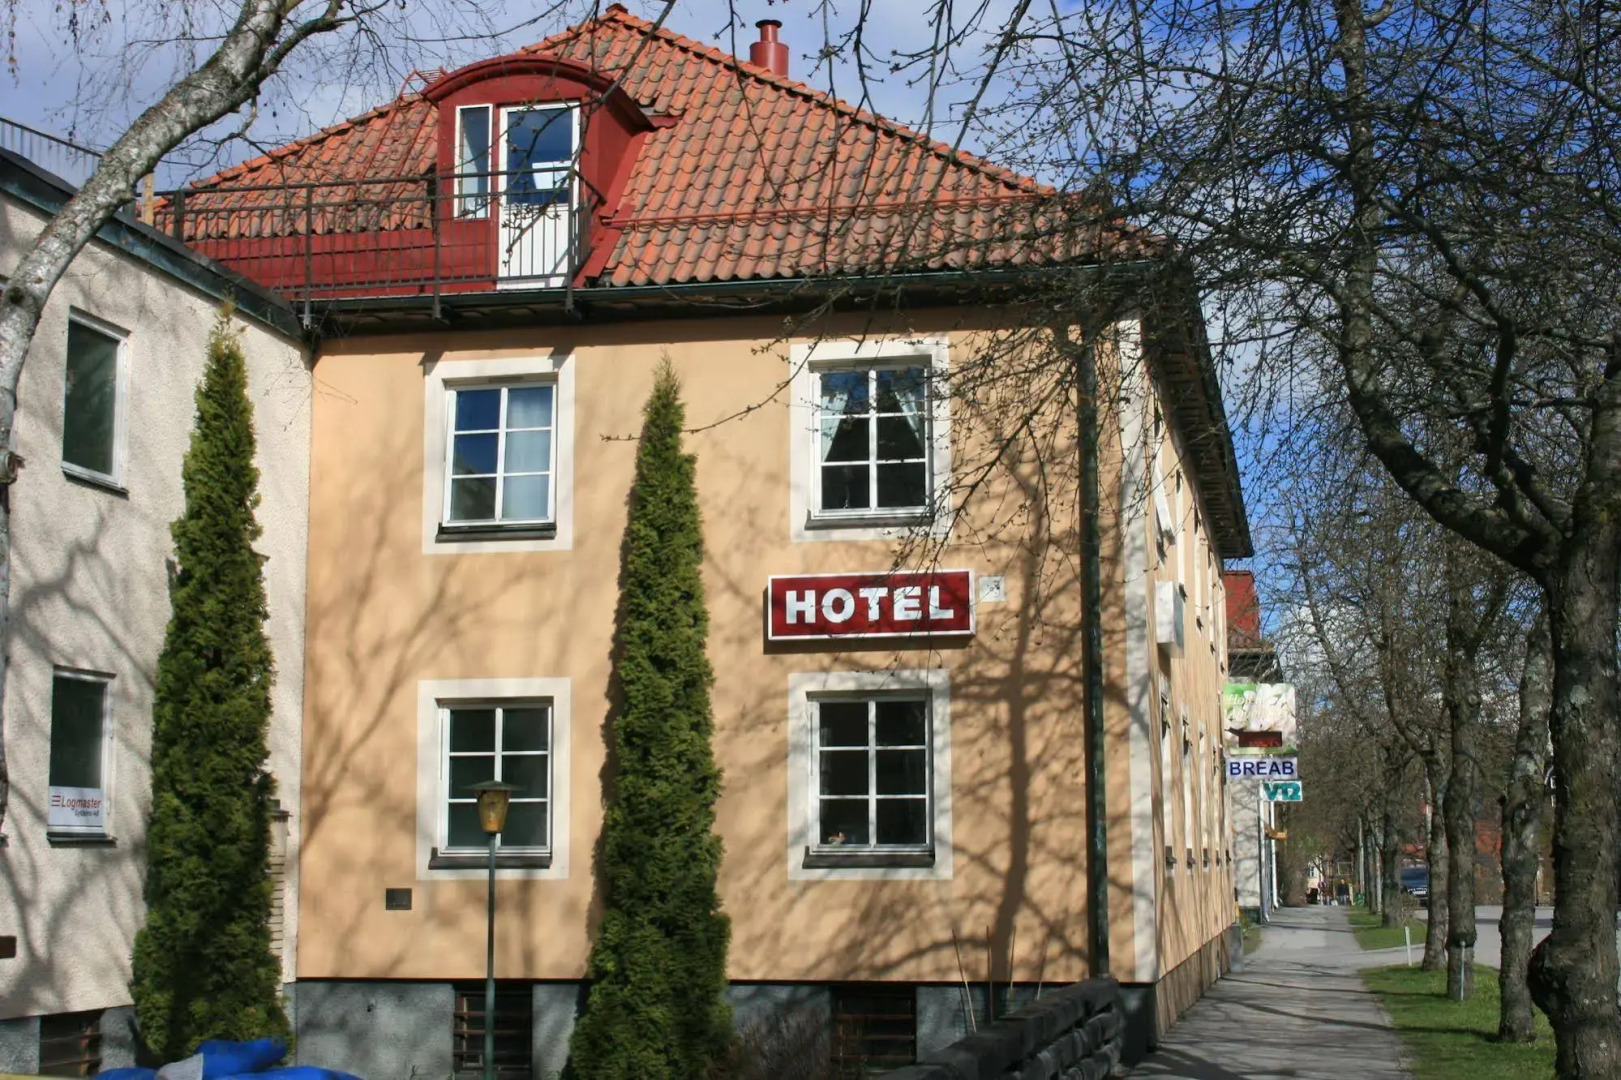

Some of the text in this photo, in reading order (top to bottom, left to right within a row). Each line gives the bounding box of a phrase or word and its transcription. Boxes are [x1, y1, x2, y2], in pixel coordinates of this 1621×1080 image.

[785, 585, 955, 624] HOTEL
[1229, 761, 1295, 776] BREAB
[1264, 782, 1301, 801] V12
[61, 796, 102, 810] Logmaster
